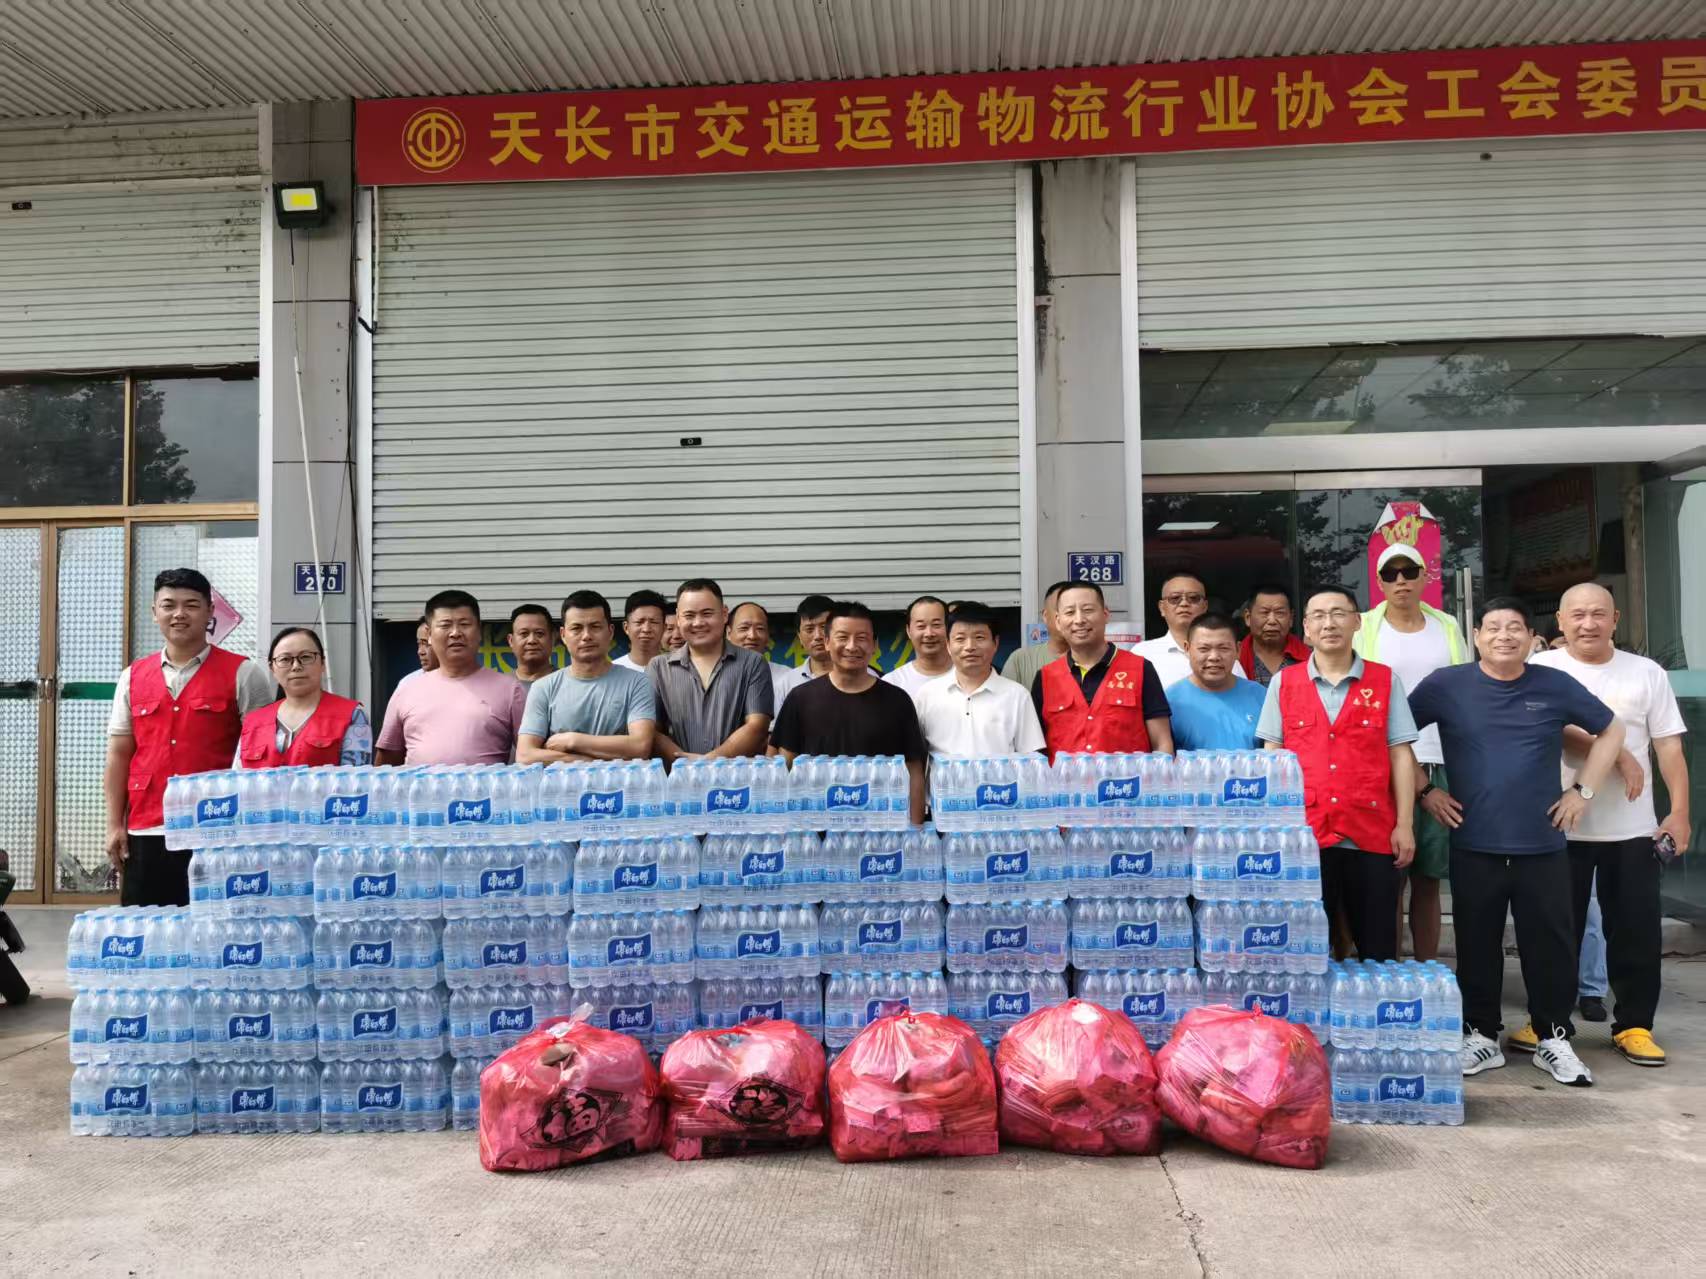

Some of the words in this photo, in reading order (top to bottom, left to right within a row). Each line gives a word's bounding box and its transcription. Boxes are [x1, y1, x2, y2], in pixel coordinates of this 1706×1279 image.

[489, 56, 1706, 167] 天长市交通运输物流行业协会工会委员
[1075, 555, 1115, 565] 天汉路
[1080, 567, 1111, 581] 268
